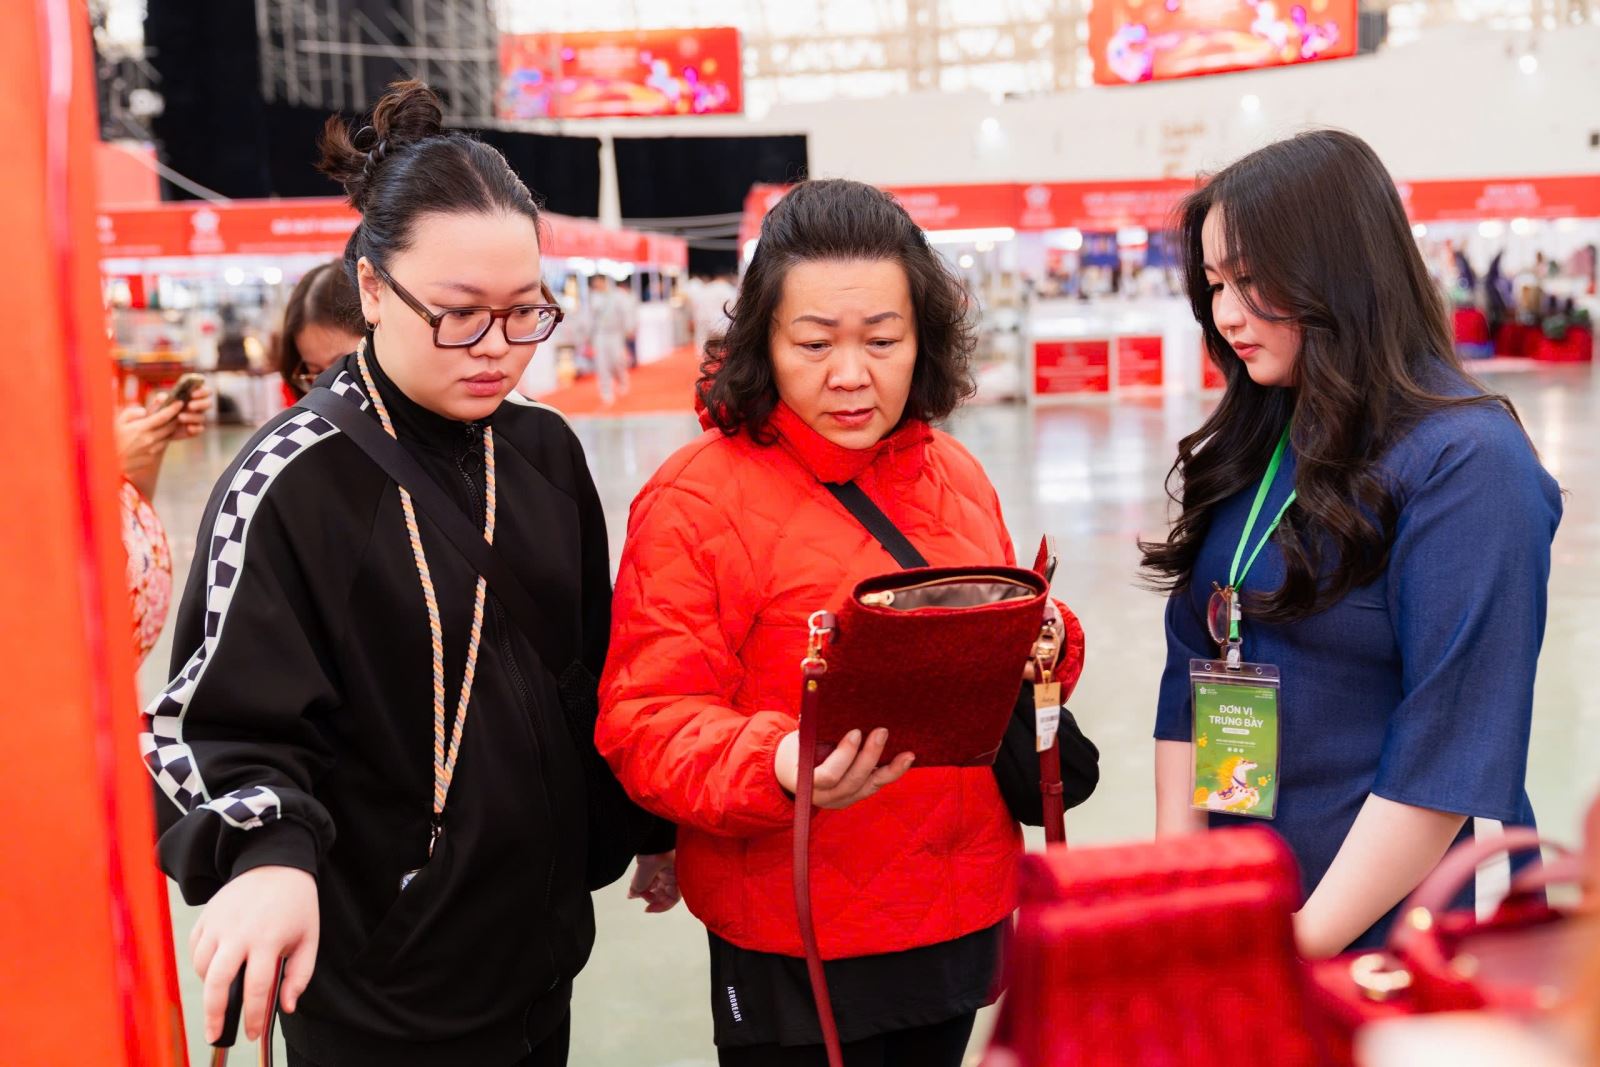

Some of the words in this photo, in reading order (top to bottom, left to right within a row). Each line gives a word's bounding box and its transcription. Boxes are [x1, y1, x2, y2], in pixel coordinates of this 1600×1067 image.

[1219, 704, 1241, 714] ĐƠN
[1243, 706, 1253, 717] VỊ
[1208, 715, 1242, 726] TRƯNG
[1244, 715, 1264, 728] BÀY
[727, 986, 742, 1022] AEROREADY
